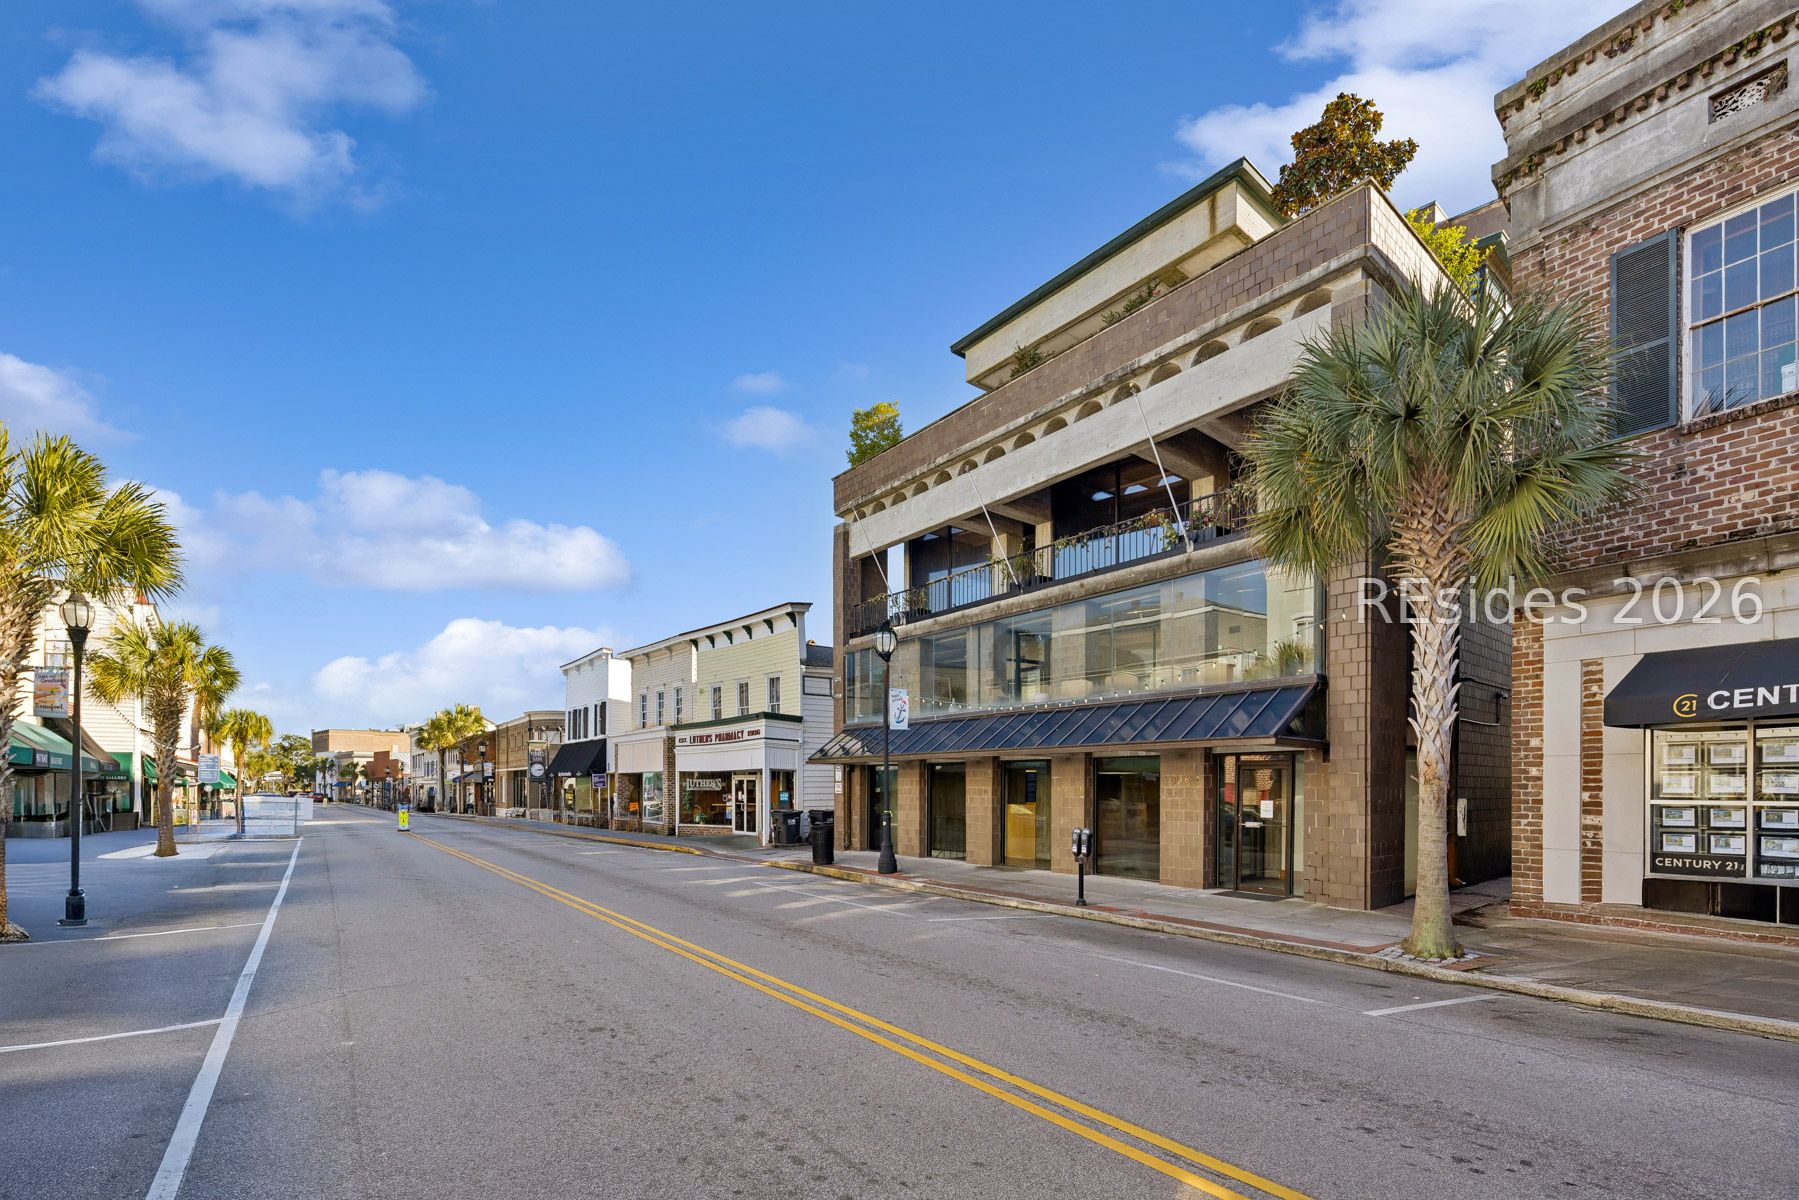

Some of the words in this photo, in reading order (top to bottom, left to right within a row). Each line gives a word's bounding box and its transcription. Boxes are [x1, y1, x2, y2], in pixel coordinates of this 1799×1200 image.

[689, 734, 713, 744] LUTHER'S
[715, 730, 744, 742] PHARMACY
[1655, 857, 1722, 870] CENTURY
[1725, 861, 1738, 871] 21
